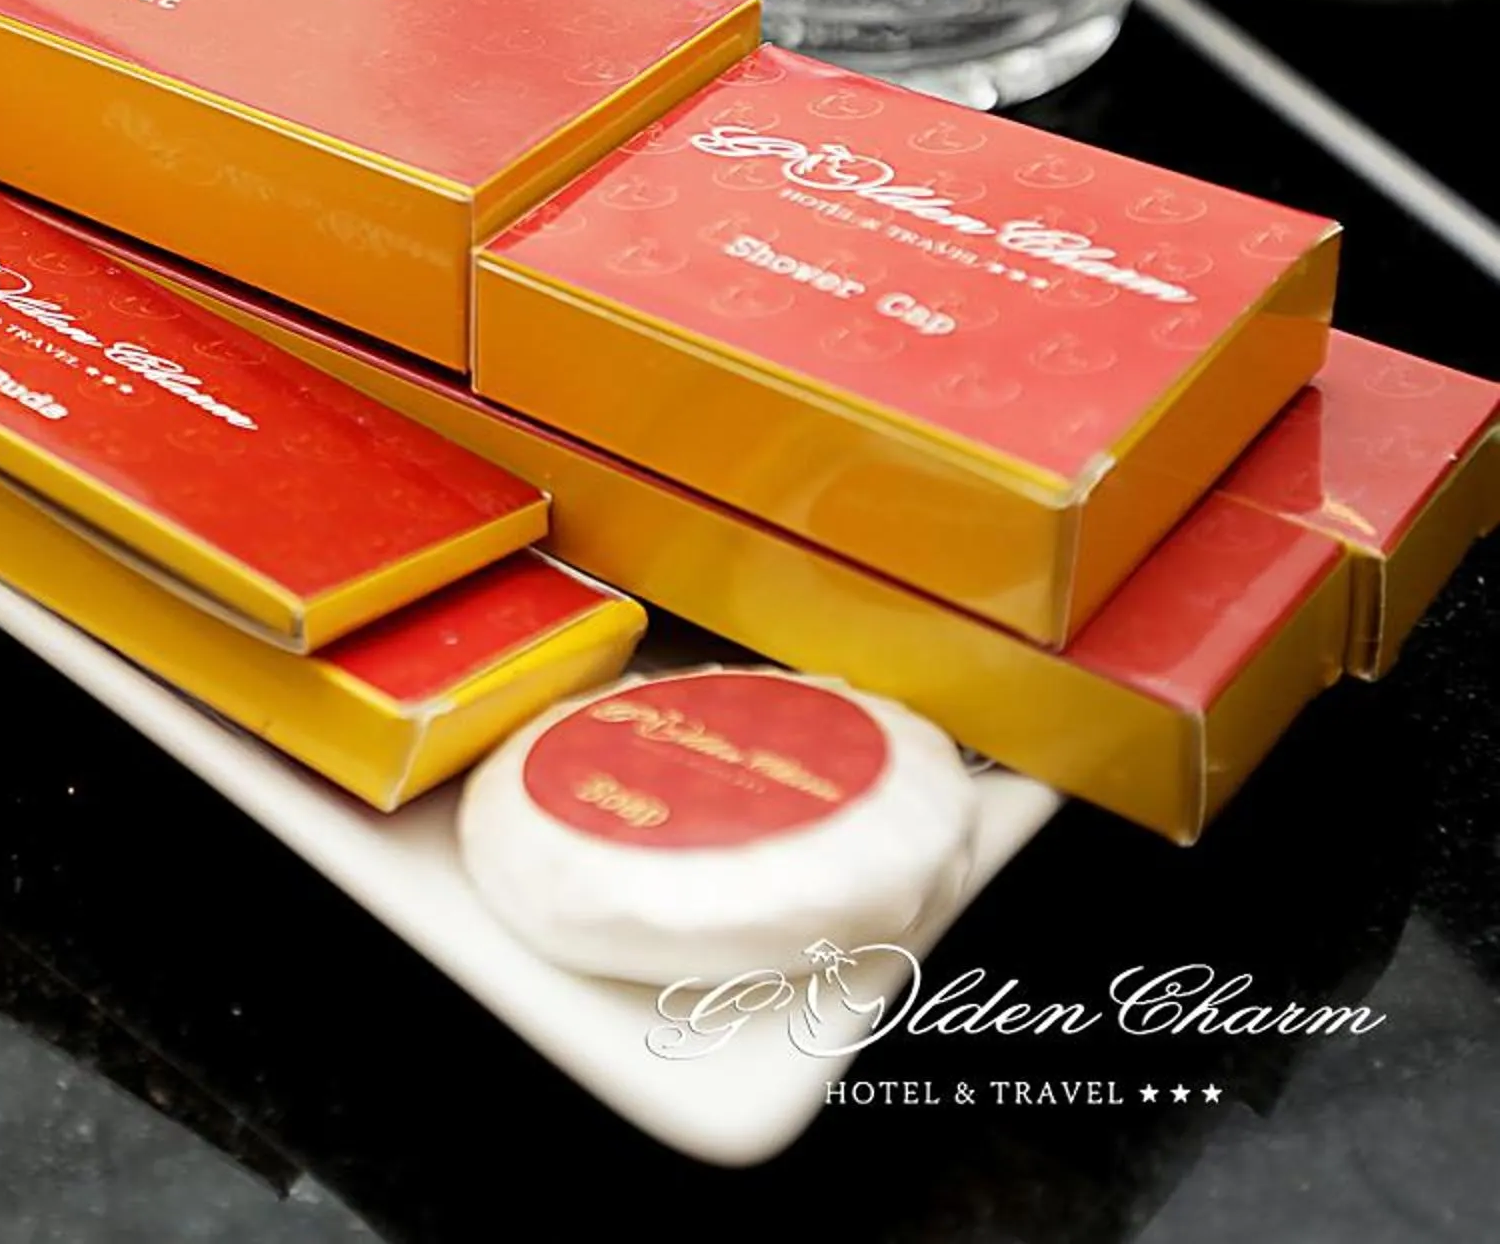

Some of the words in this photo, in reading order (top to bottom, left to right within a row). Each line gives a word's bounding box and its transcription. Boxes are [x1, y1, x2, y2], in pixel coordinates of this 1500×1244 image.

[725, 235, 865, 299] Shower
[876, 291, 958, 335] Cap
[5, 322, 80, 370] TRAVEL
